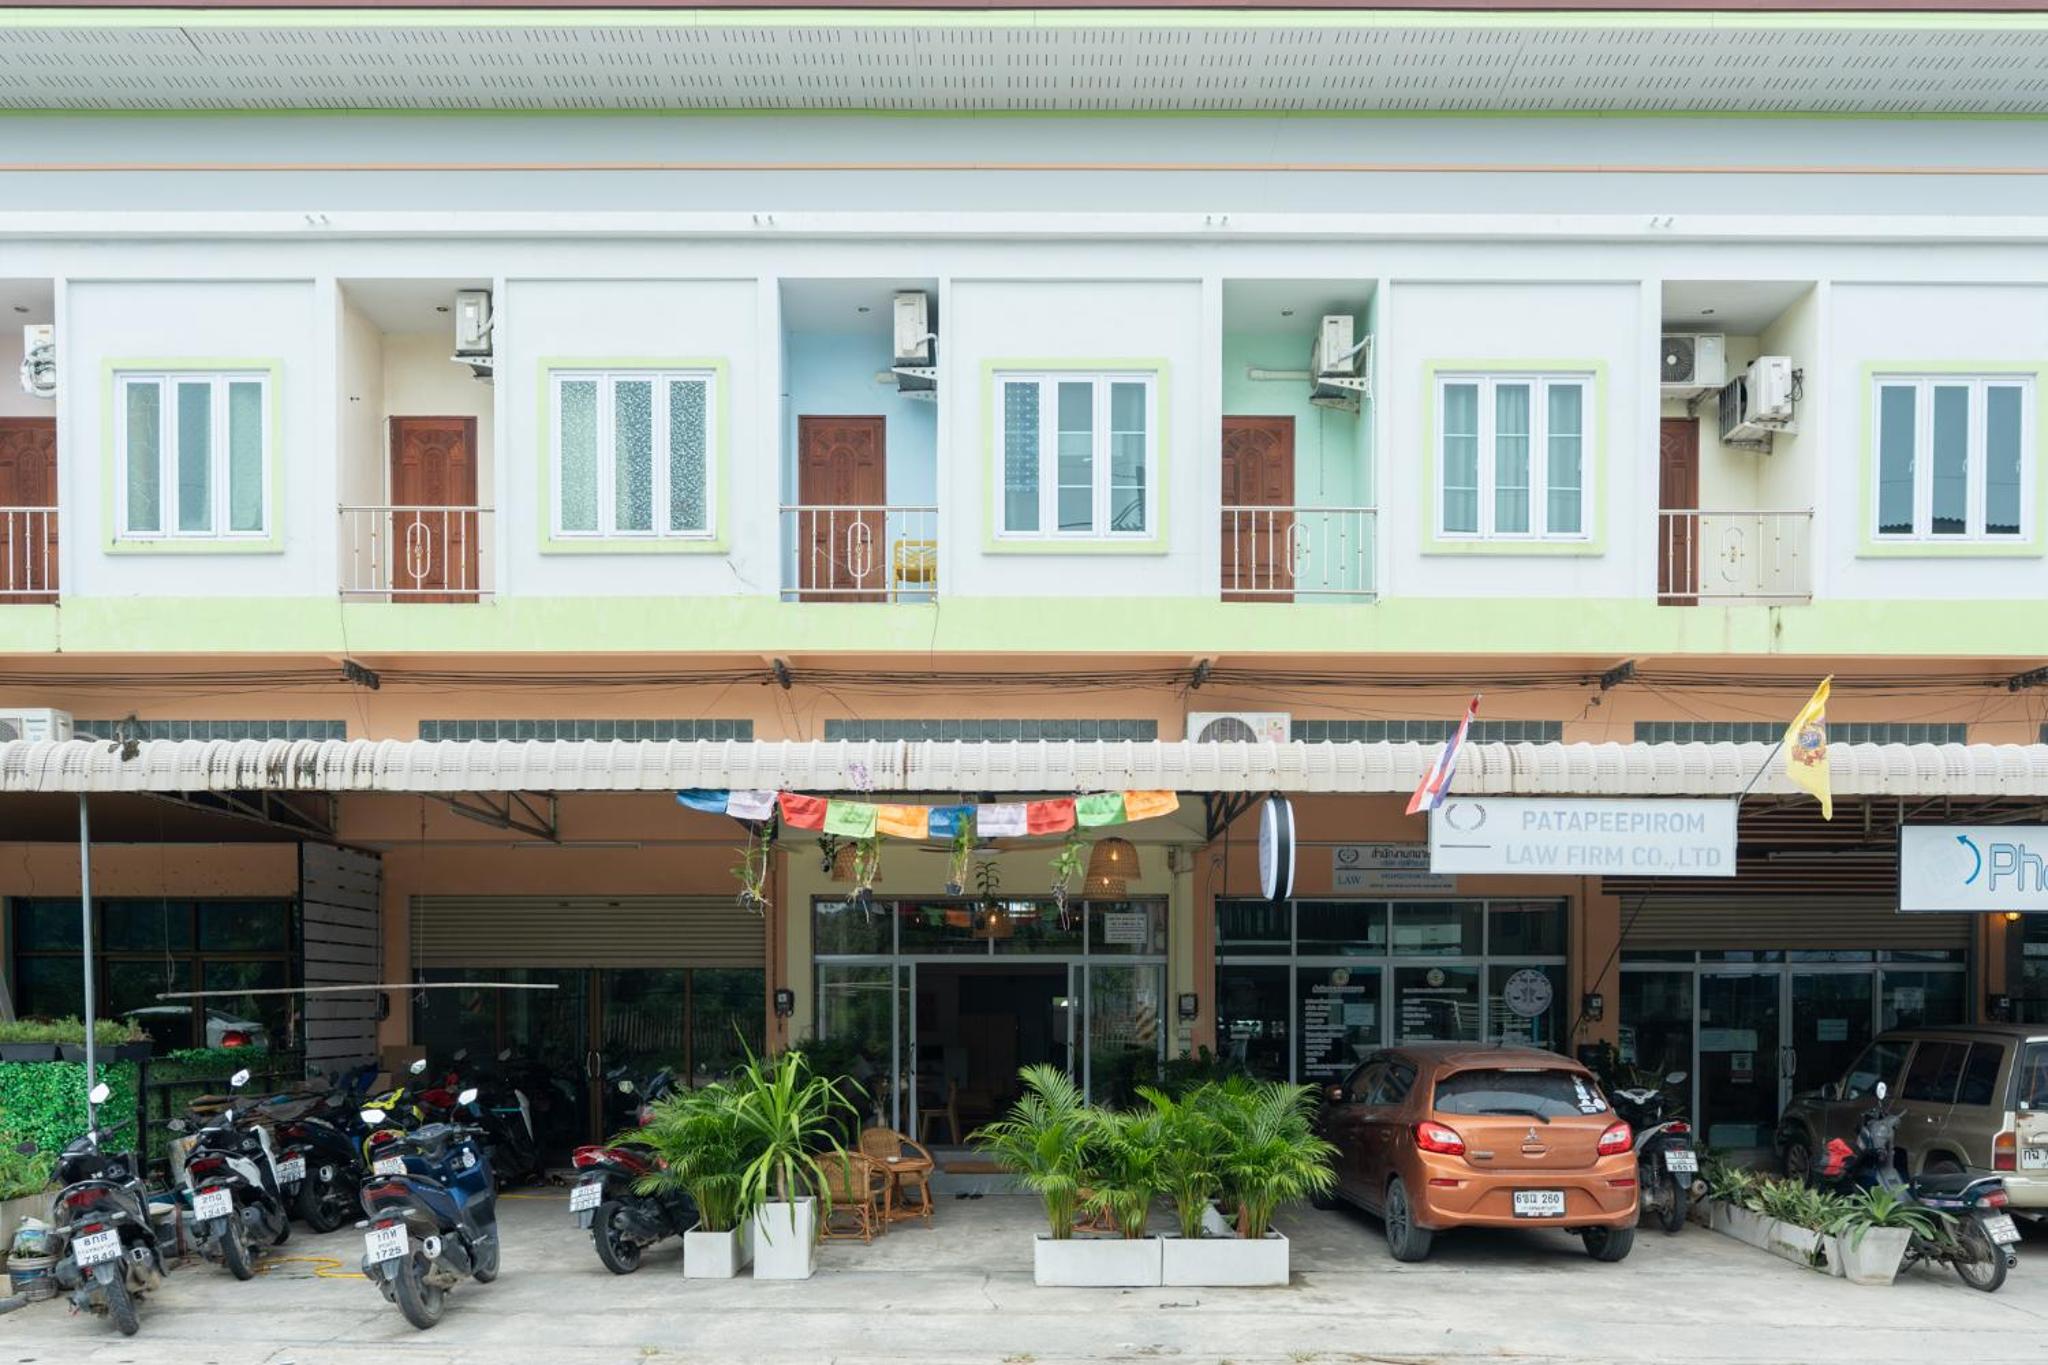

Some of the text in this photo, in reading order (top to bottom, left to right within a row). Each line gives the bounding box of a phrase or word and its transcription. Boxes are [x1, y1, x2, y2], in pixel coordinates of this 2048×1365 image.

[1522, 810, 1705, 834] PATAPEEPIROM
[1506, 844, 1721, 869] LAW FIRM CO.,LTD
[1989, 843, 2048, 892] Ph
[1338, 875, 1361, 886] LAW
